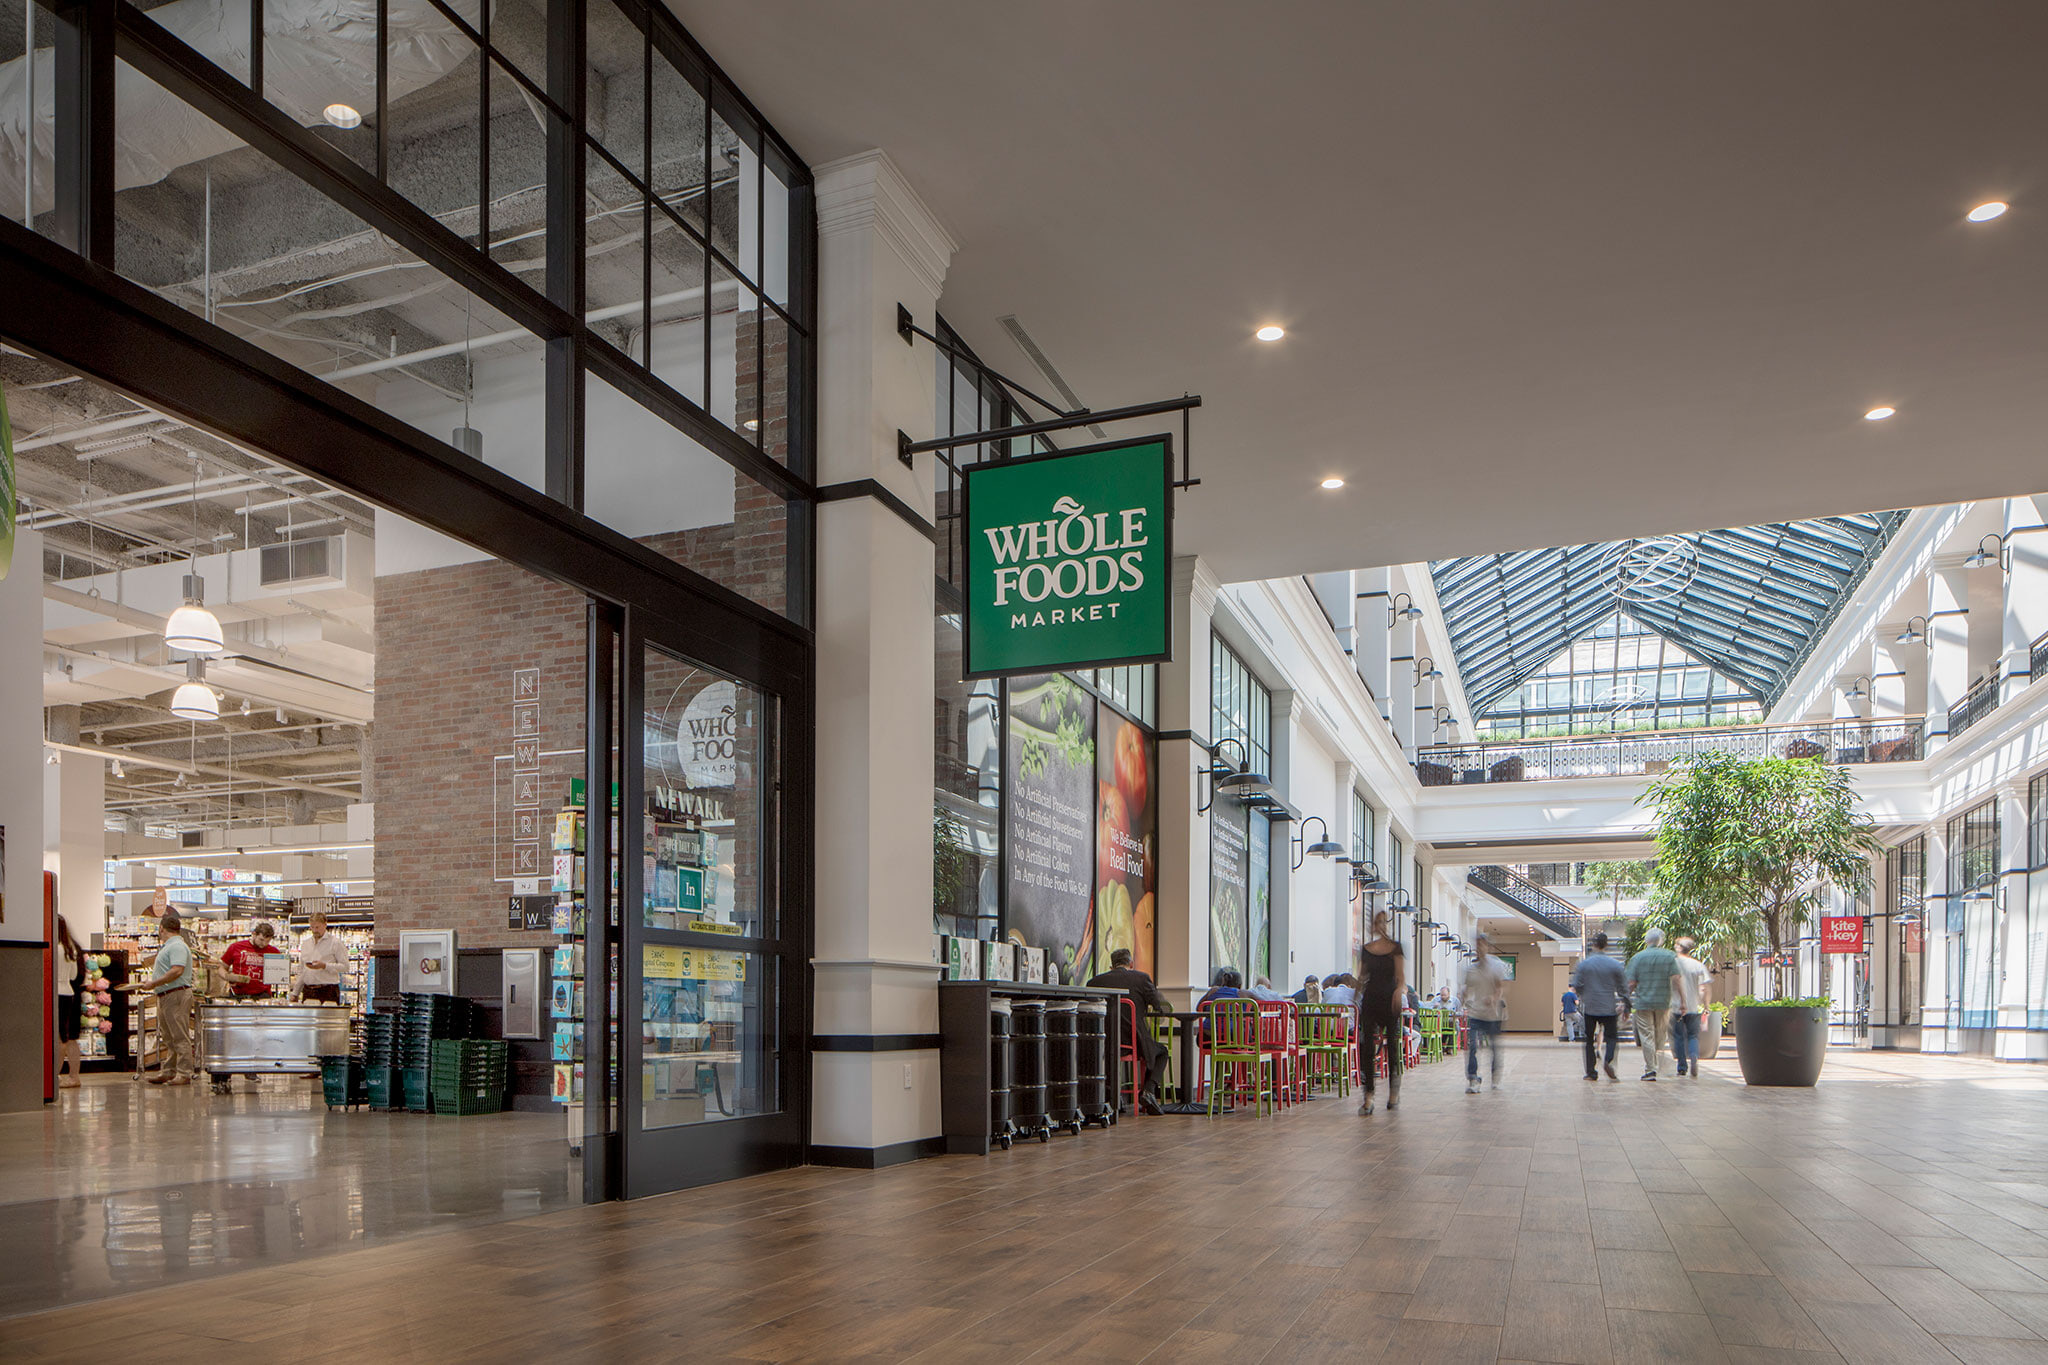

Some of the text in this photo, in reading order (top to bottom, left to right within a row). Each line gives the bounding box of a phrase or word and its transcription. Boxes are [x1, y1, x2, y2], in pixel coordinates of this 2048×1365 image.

[984, 495, 1148, 564] WHOLE
[993, 551, 1144, 606] FOODS
[1011, 603, 1121, 629] MARKET
[655, 785, 725, 820] NEWARK
[1014, 780, 1088, 823] No Artificial Preservatives
[1014, 801, 1083, 841] No Artificial Sweeteners
[1014, 822, 1073, 856] No Artificial Flavors
[1110, 827, 1144, 854] We Believe in
[1014, 843, 1070, 874] No Artificial Colors
[1110, 848, 1144, 878] Real Food
[686, 882, 696, 896] In
[1014, 865, 1088, 898] In Any of the Food We Sell
[526, 912, 539, 925] W
[1831, 920, 1857, 931] kite
